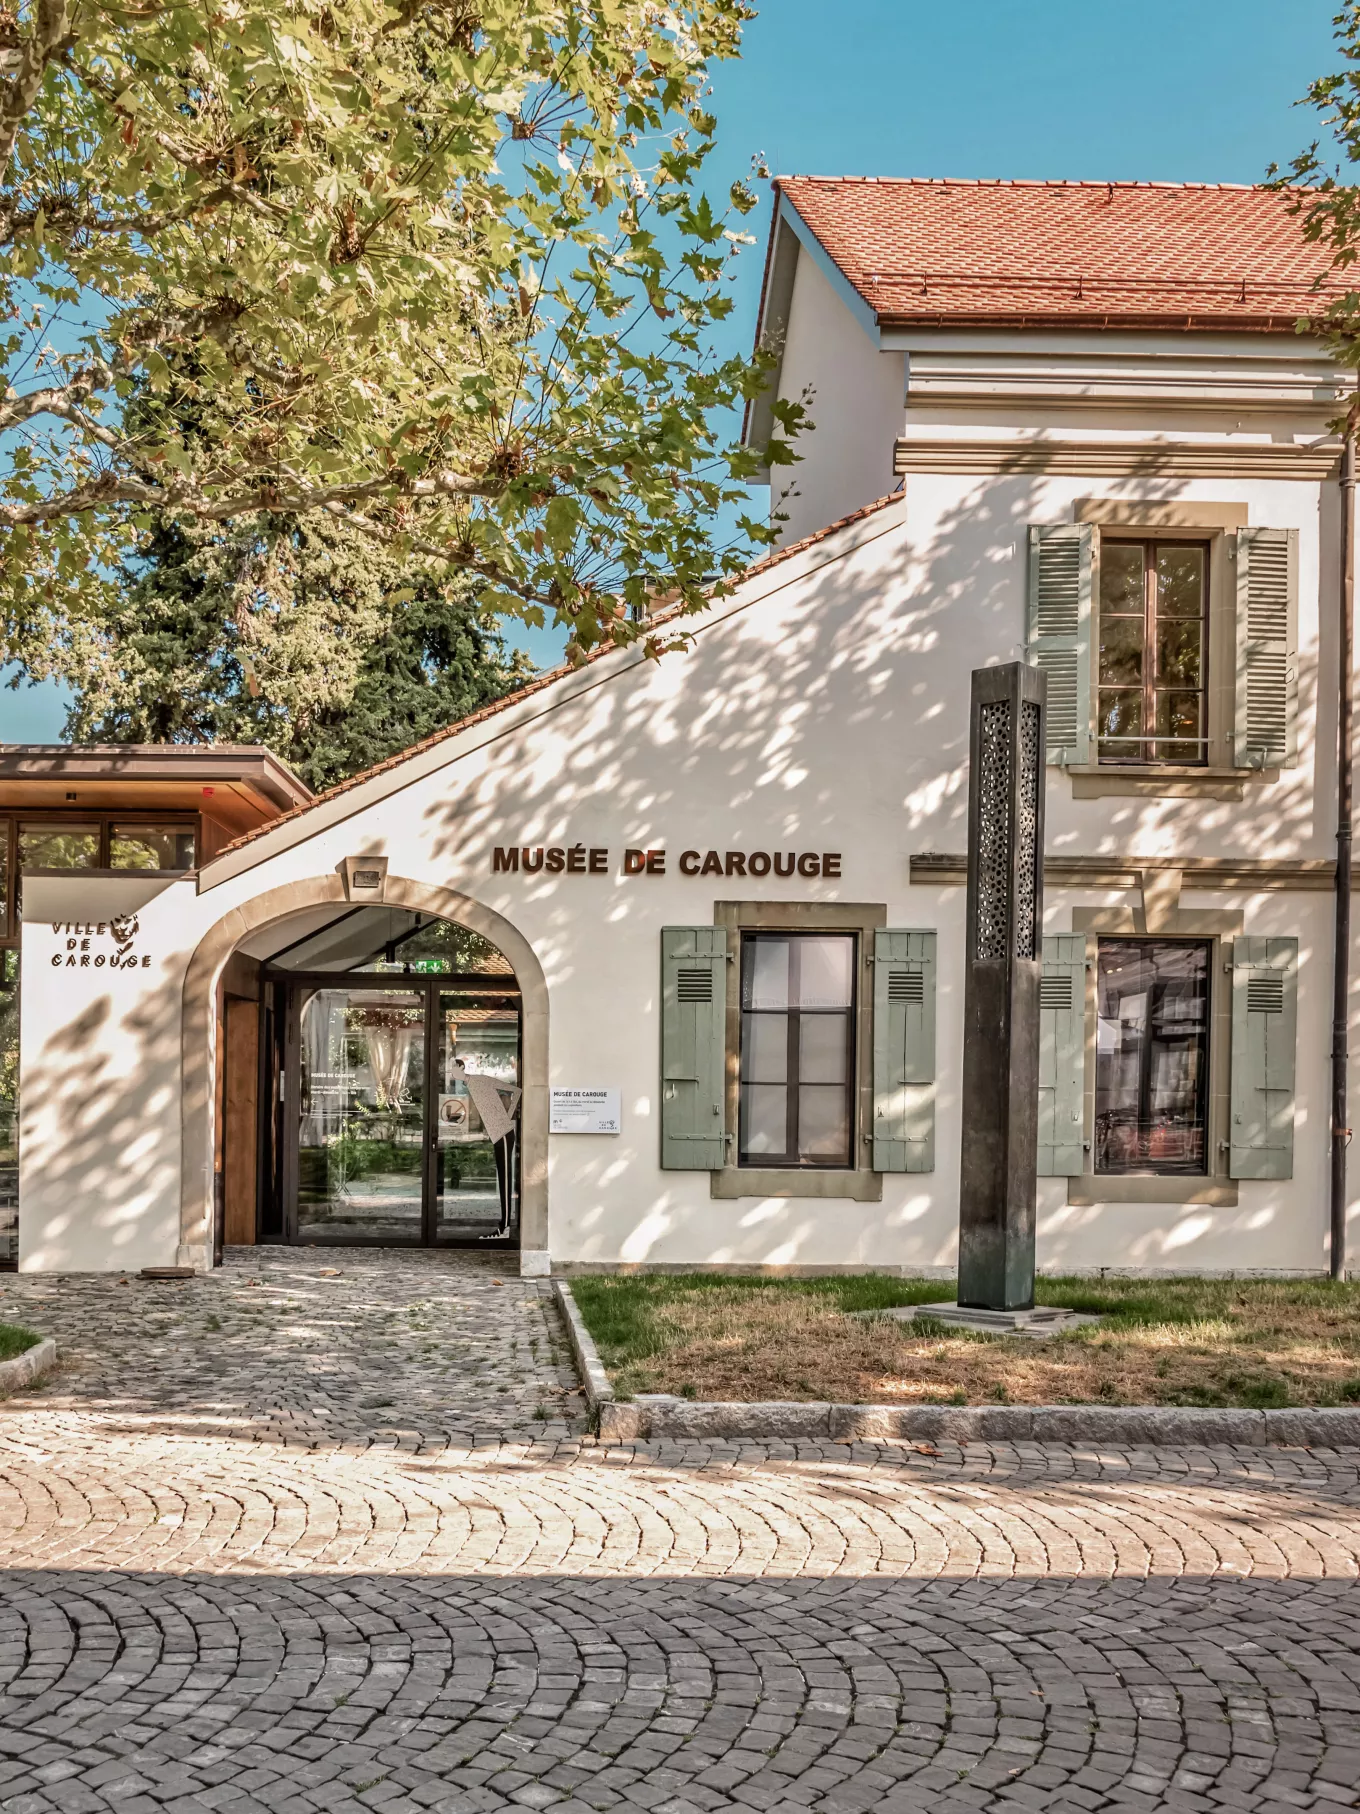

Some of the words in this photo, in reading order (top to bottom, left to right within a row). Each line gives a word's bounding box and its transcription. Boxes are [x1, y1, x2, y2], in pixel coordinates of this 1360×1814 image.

[493, 843, 609, 873] MUSÉE
[624, 849, 666, 874] DE
[679, 850, 842, 878] CAROUGE
[52, 922, 106, 935] VILLE
[66, 938, 91, 951] DE
[51, 953, 152, 968] CAROUGE
